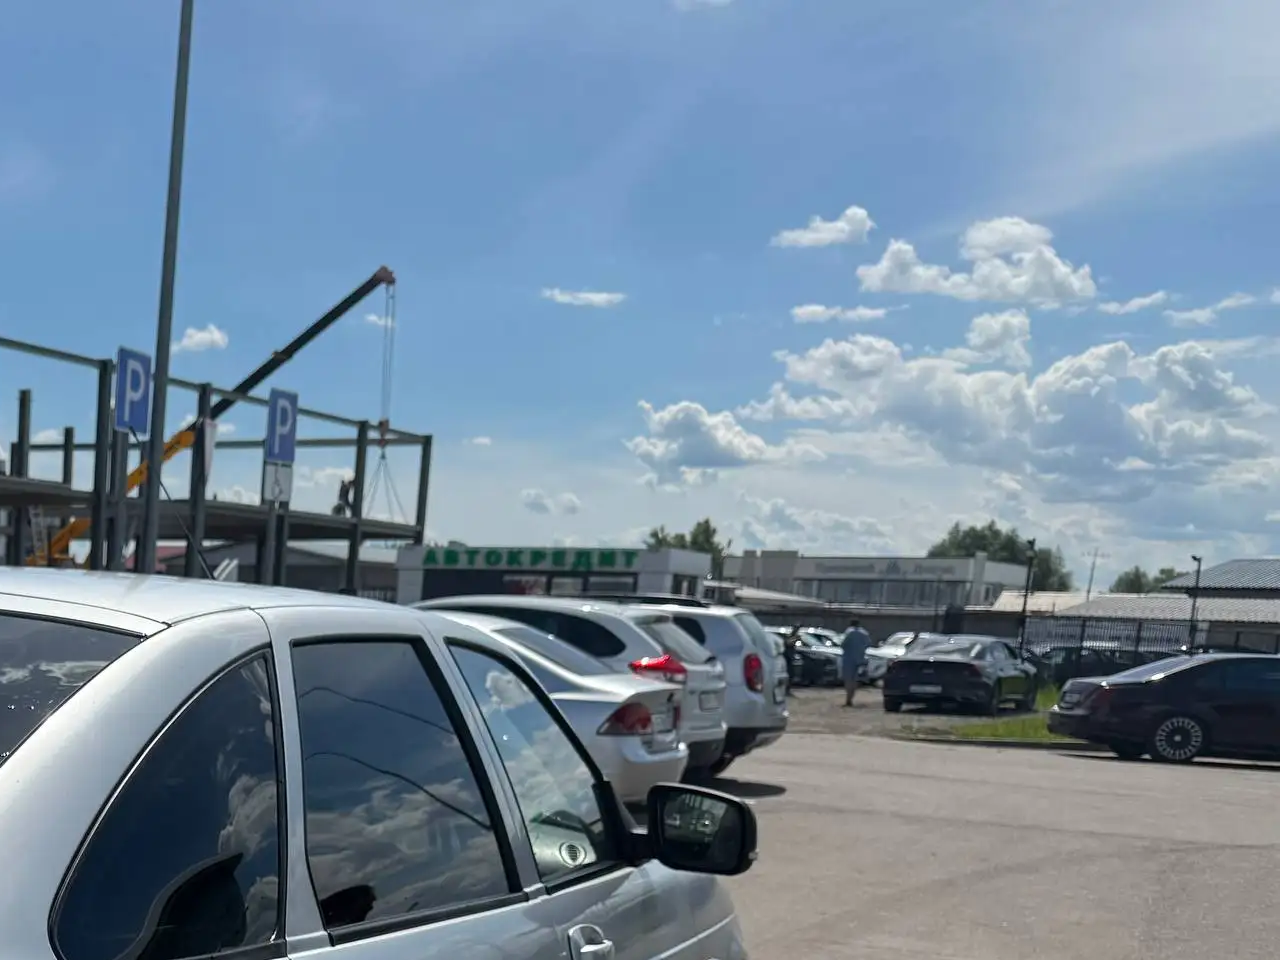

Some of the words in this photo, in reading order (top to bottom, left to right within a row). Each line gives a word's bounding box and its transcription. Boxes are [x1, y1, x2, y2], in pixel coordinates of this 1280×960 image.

[124, 359, 145, 422] P
[274, 397, 292, 454] P
[422, 548, 638, 571] АВТОКРЕДИТ
